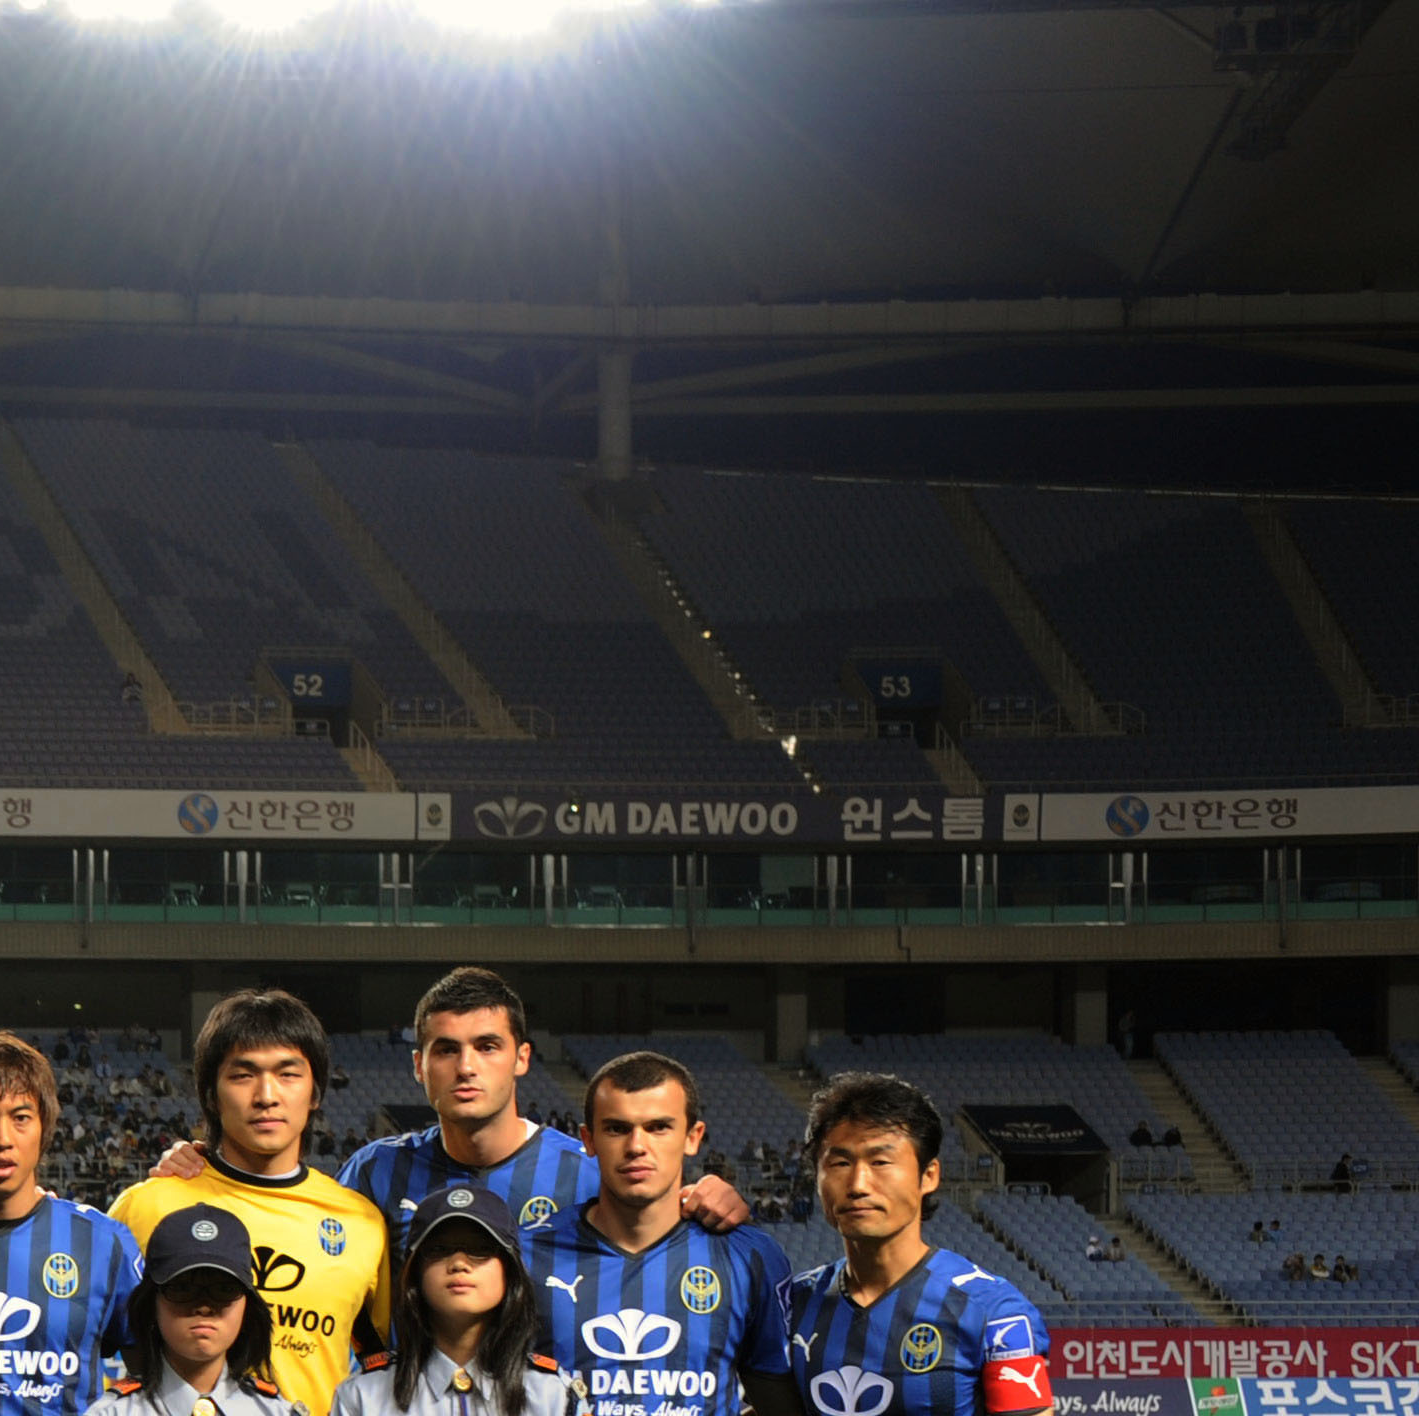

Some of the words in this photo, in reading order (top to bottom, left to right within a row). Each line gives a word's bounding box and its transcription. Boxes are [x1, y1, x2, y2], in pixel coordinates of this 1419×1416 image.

[293, 674, 323, 697] 52
[880, 676, 911, 699] 53
[224, 799, 355, 832] 신한은행
[555, 802, 616, 836] GM
[627, 802, 798, 836] DAEWOO
[841, 797, 985, 842] 원스톰
[1155, 798, 1298, 832] 신한은행
[271, 1303, 335, 1337] WOO
[591, 1370, 716, 1397] DAEWOO
